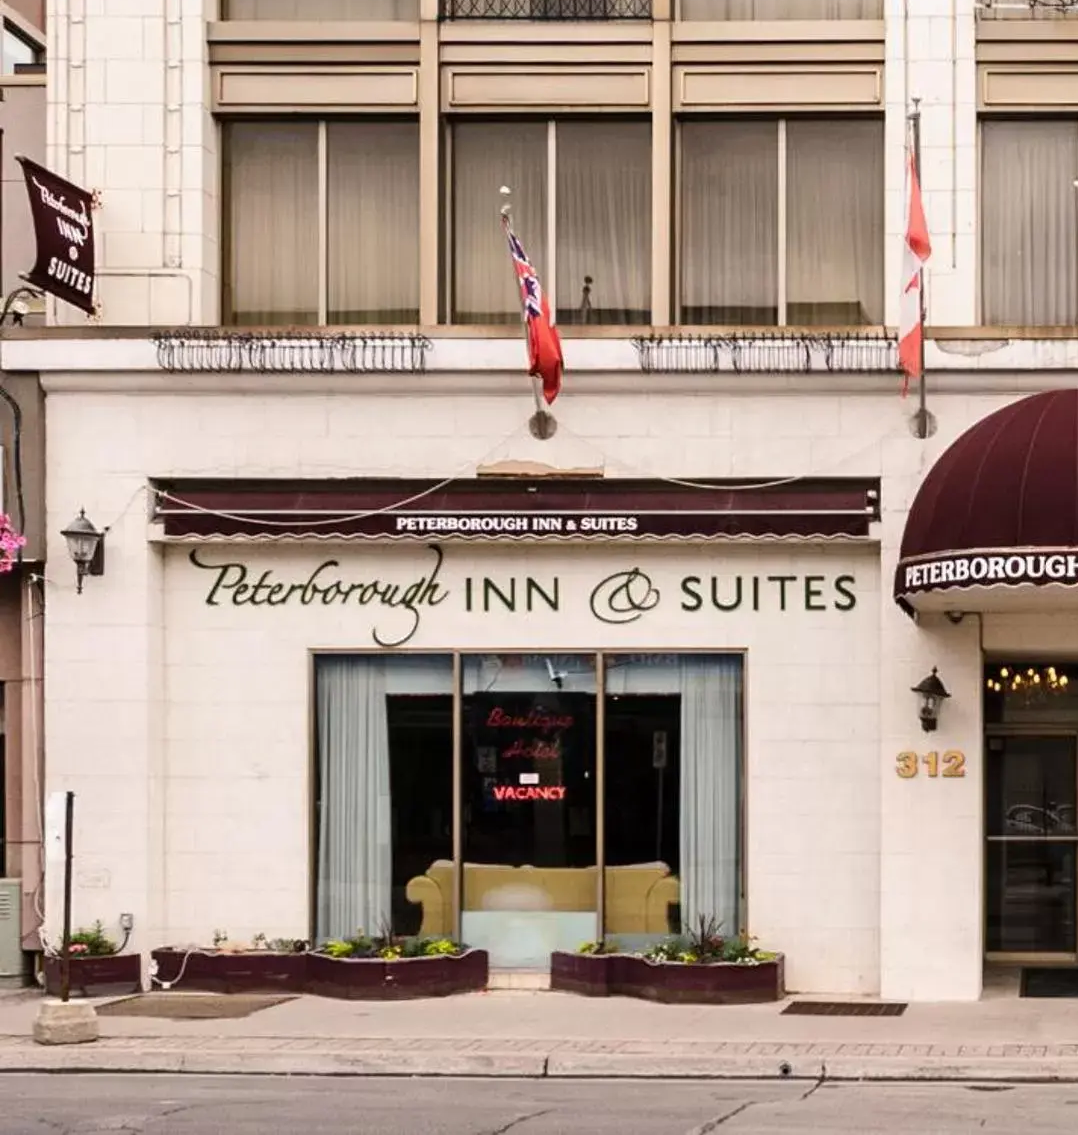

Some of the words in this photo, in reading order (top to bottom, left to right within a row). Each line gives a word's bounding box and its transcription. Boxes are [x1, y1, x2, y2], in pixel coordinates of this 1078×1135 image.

[56, 216, 84, 246] INN
[47, 257, 92, 294] SUITES
[396, 517, 528, 531] PETERBOROUGH
[532, 517, 562, 531] INN
[566, 520, 576, 531] &
[580, 517, 638, 531] SUITES
[189, 544, 450, 646] Peterborough
[465, 577, 559, 612] INN
[680, 575, 857, 612] SUITES
[895, 751, 966, 778] 312
[493, 786, 566, 800] VACANCY
